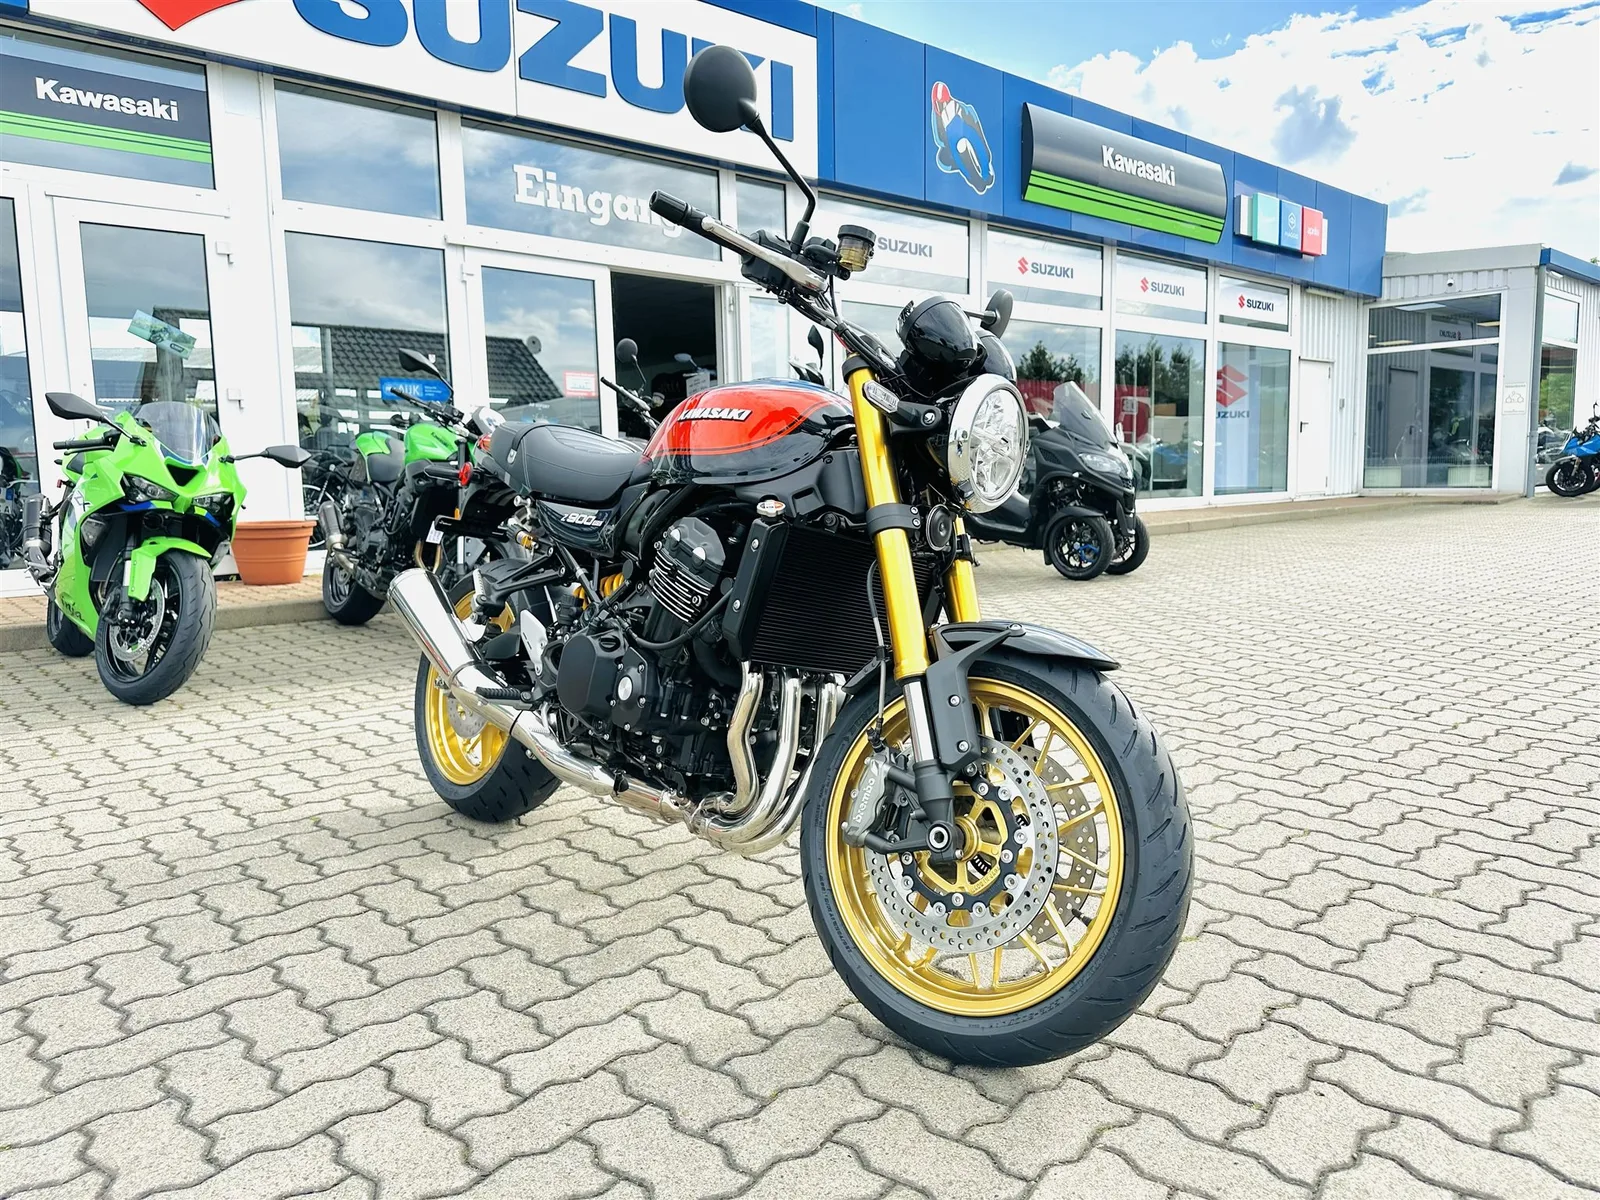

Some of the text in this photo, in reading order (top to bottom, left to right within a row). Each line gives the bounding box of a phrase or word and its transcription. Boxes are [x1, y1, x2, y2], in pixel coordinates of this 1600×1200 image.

[35, 77, 179, 122] Kawasaki
[1102, 145, 1176, 187] Kawasaki
[513, 164, 682, 238] Eingan
[878, 236, 933, 258] SUZUKI
[1031, 262, 1074, 279] SUZUKI
[1150, 281, 1185, 297] SUZUKI
[1246, 298, 1274, 312] SUZUKI
[677, 407, 752, 421] KAWASAKI
[853, 777, 876, 823] brembo
